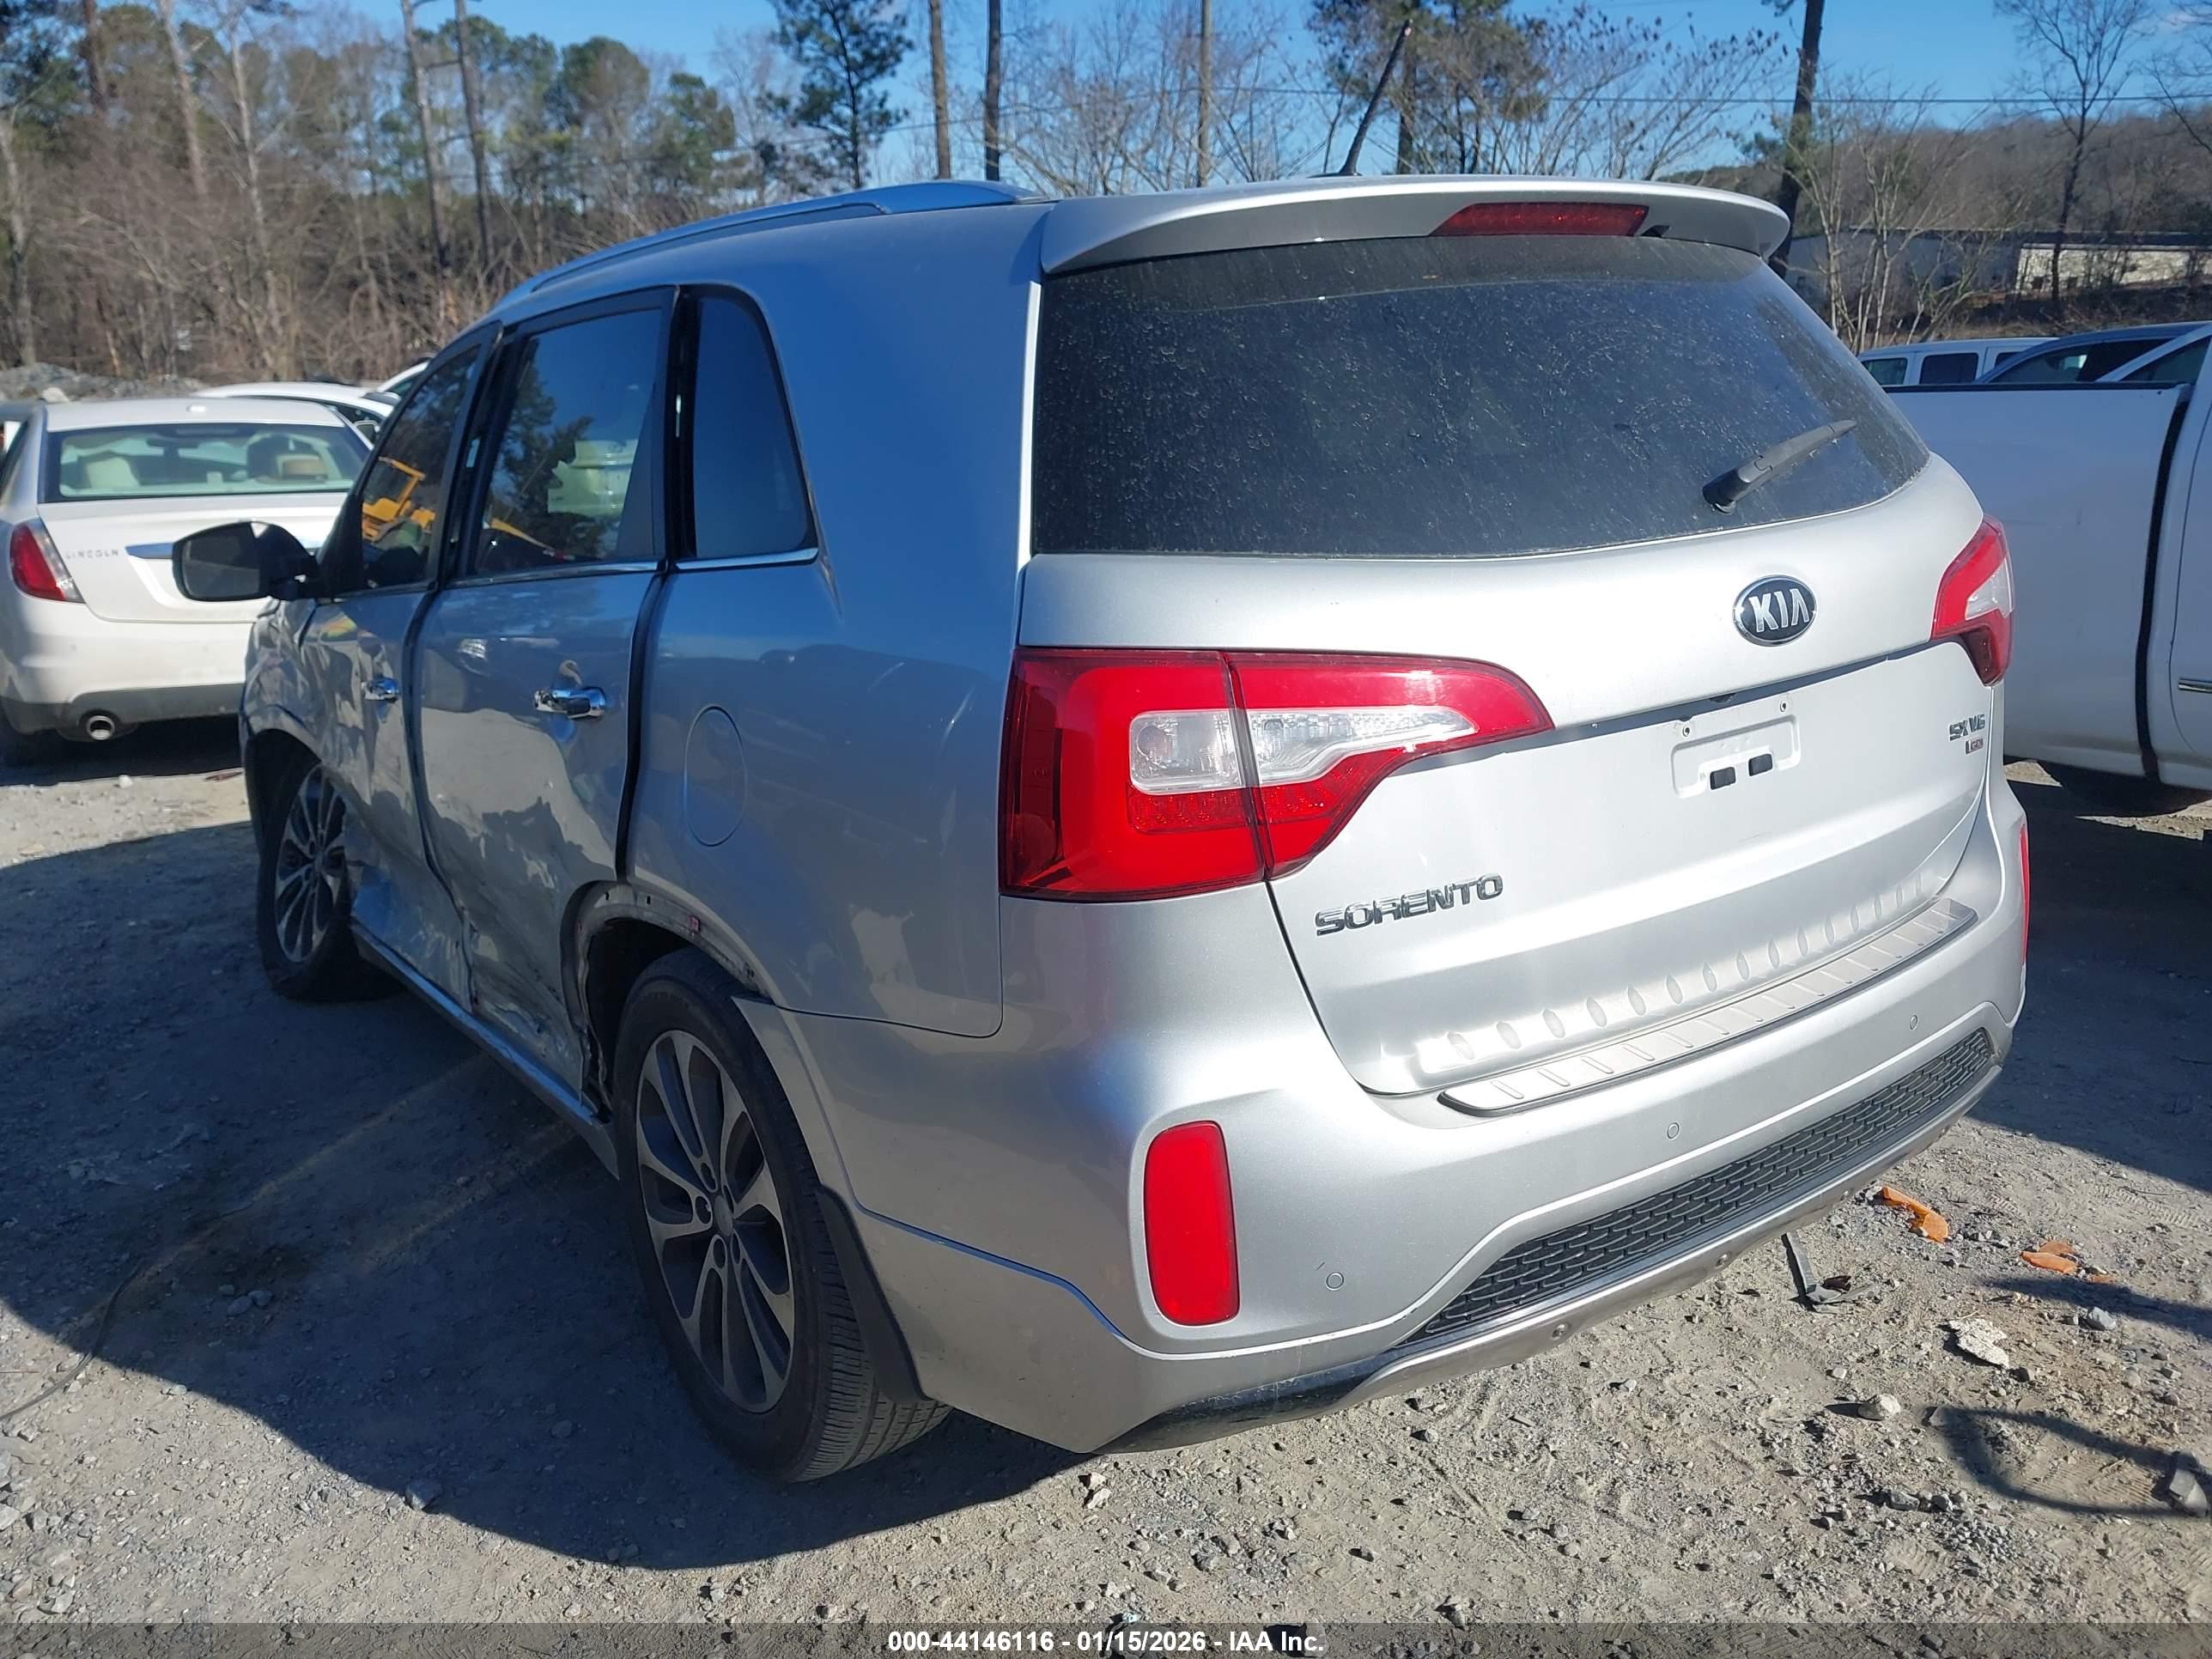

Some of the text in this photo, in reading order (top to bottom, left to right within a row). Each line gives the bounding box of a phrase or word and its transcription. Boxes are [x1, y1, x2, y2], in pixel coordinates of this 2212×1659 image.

[66, 550, 119, 560] LINCOLN
[1748, 588, 1810, 633] KIA
[1948, 714, 1985, 741] SX V6
[1315, 873, 1504, 936] SORENTO
